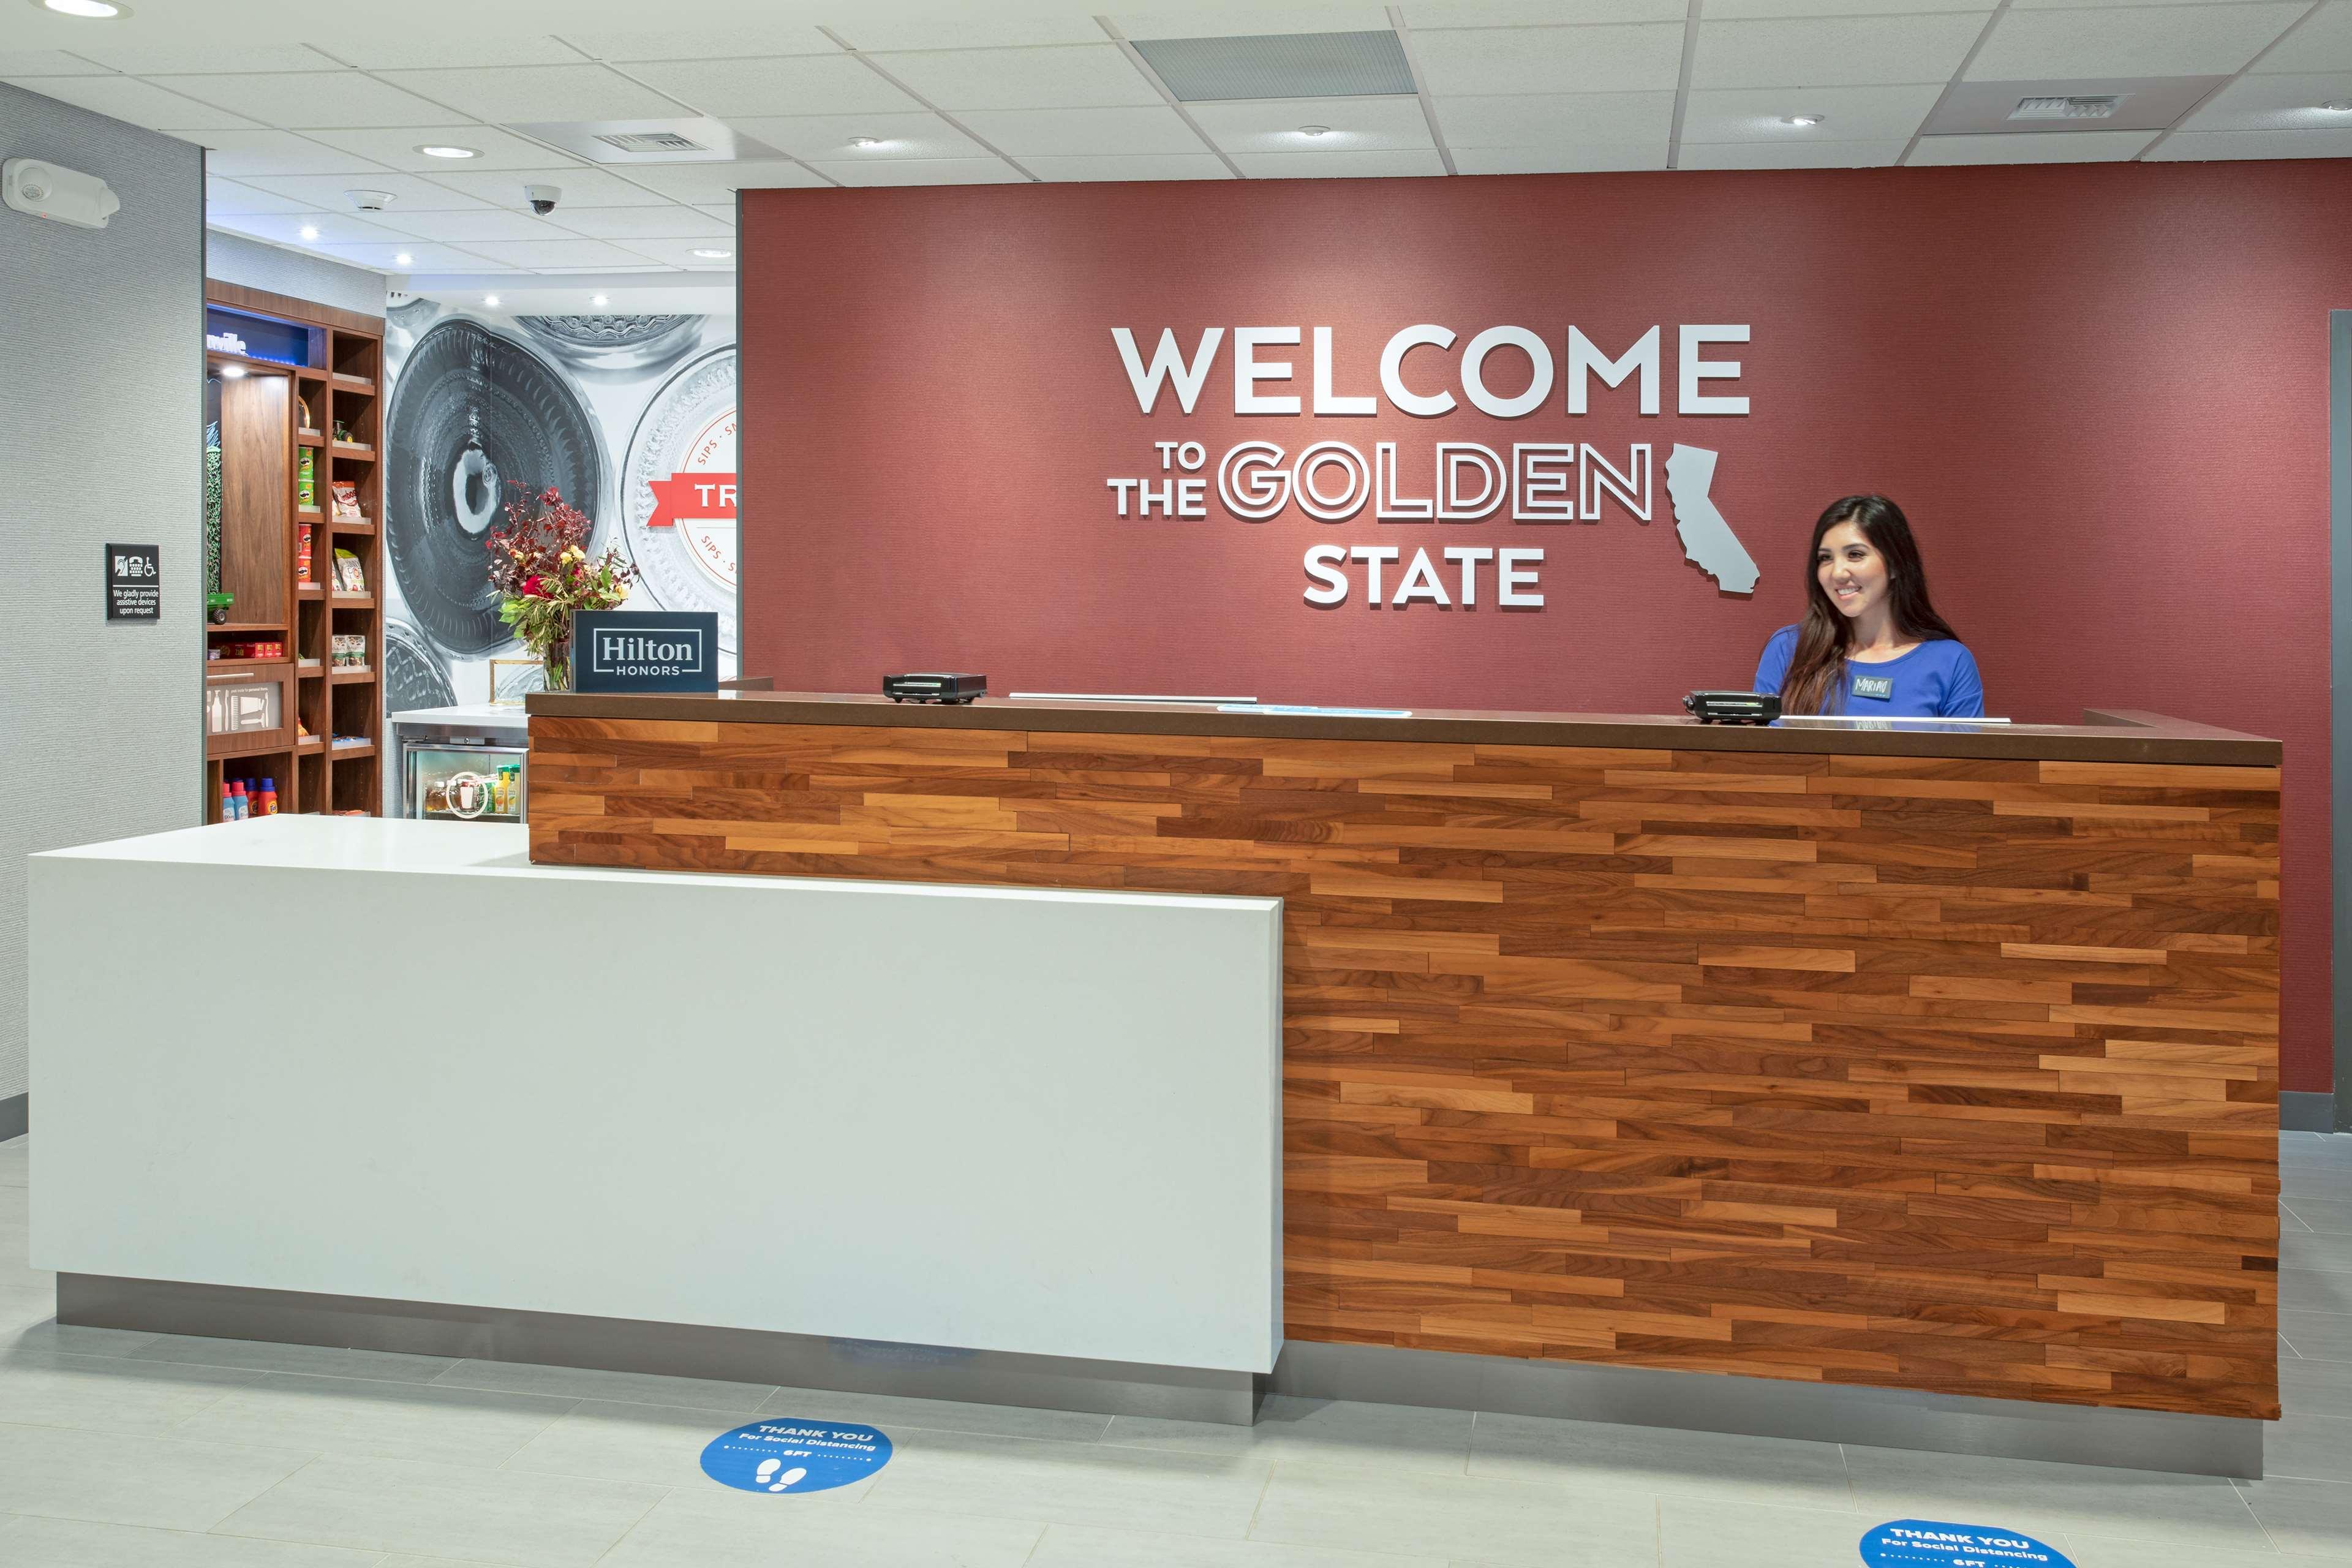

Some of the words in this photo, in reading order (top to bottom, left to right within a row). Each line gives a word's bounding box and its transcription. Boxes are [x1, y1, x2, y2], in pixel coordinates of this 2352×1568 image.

[1110, 324, 1750, 417] WELCOME
[698, 440, 717, 466] SIPS
[1155, 441, 1207, 470] TO
[1218, 441, 1652, 521] GOLDEN
[694, 484, 737, 507] TR
[1107, 478, 1207, 516] THE
[701, 535, 722, 559] SIPS
[1303, 545, 1545, 606] STATE
[123, 589, 139, 599] gladly
[140, 589, 159, 599] provide
[603, 637, 693, 661] Hilton
[616, 666, 680, 676] HONORS
[759, 1425, 827, 1438] THANK
[832, 1431, 874, 1441] YOU
[764, 1435, 804, 1444] Social
[806, 1439, 876, 1451] Distancing
[1882, 1538, 1907, 1547] For
[1912, 1540, 1959, 1552] Social
[1962, 1545, 2048, 1561] Distancing
[1890, 1528, 1974, 1544] THANK
[1977, 1536, 2029, 1549] YOU
[1953, 1558, 1985, 1568] 6FT
